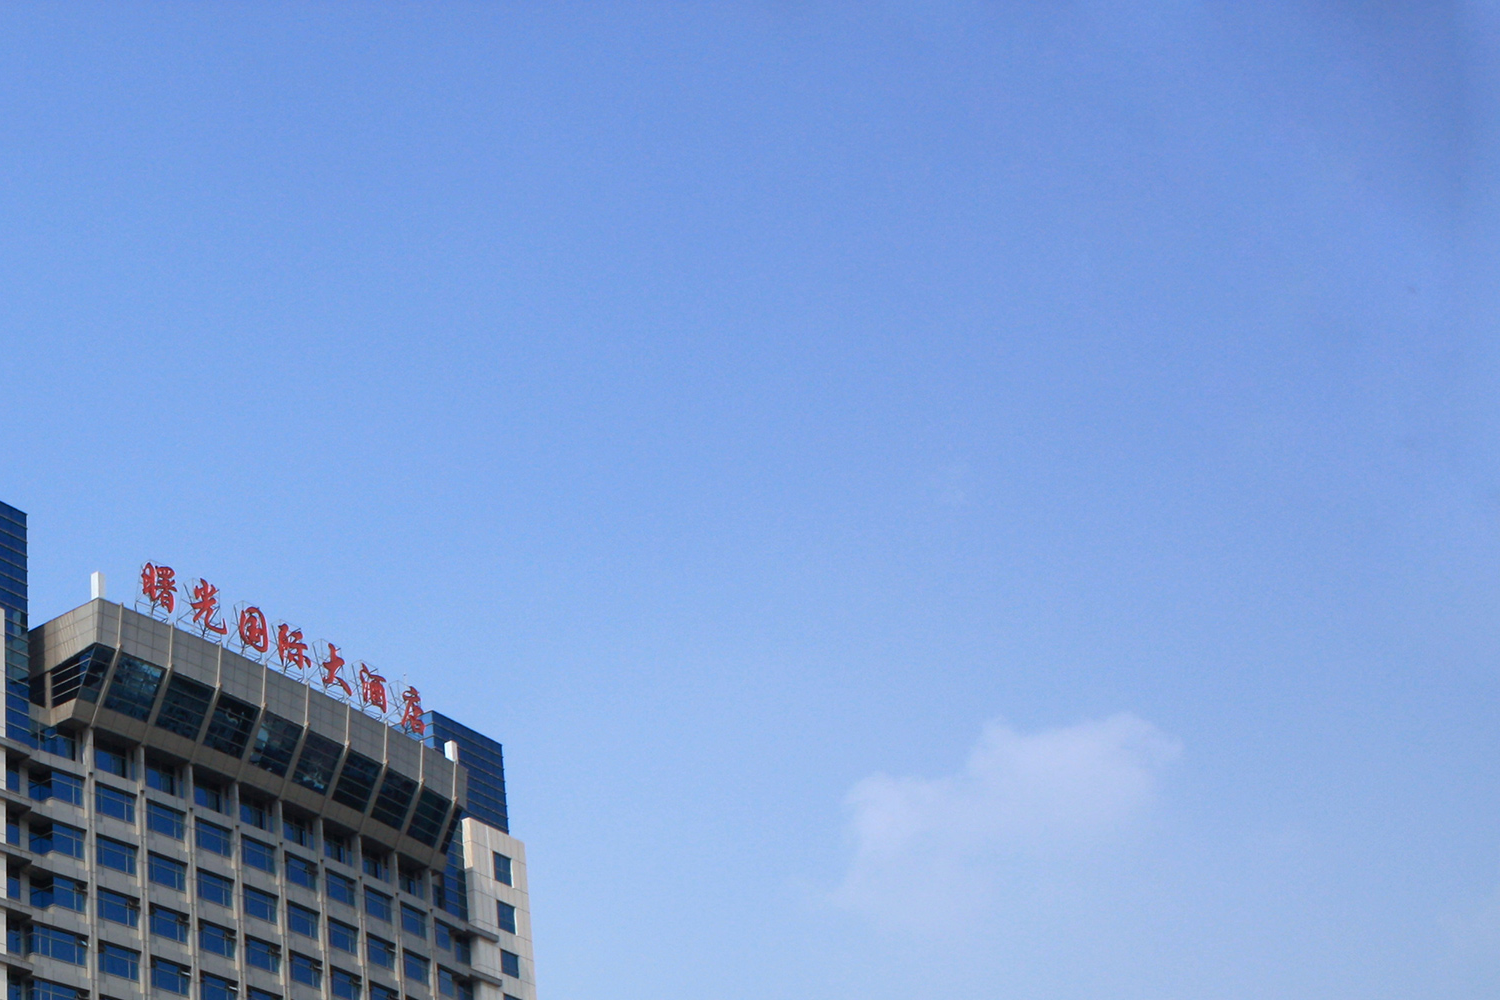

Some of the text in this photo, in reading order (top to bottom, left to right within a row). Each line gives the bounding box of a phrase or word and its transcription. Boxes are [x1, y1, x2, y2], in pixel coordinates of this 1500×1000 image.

[141, 562, 426, 736] 曙光国际大酒店
